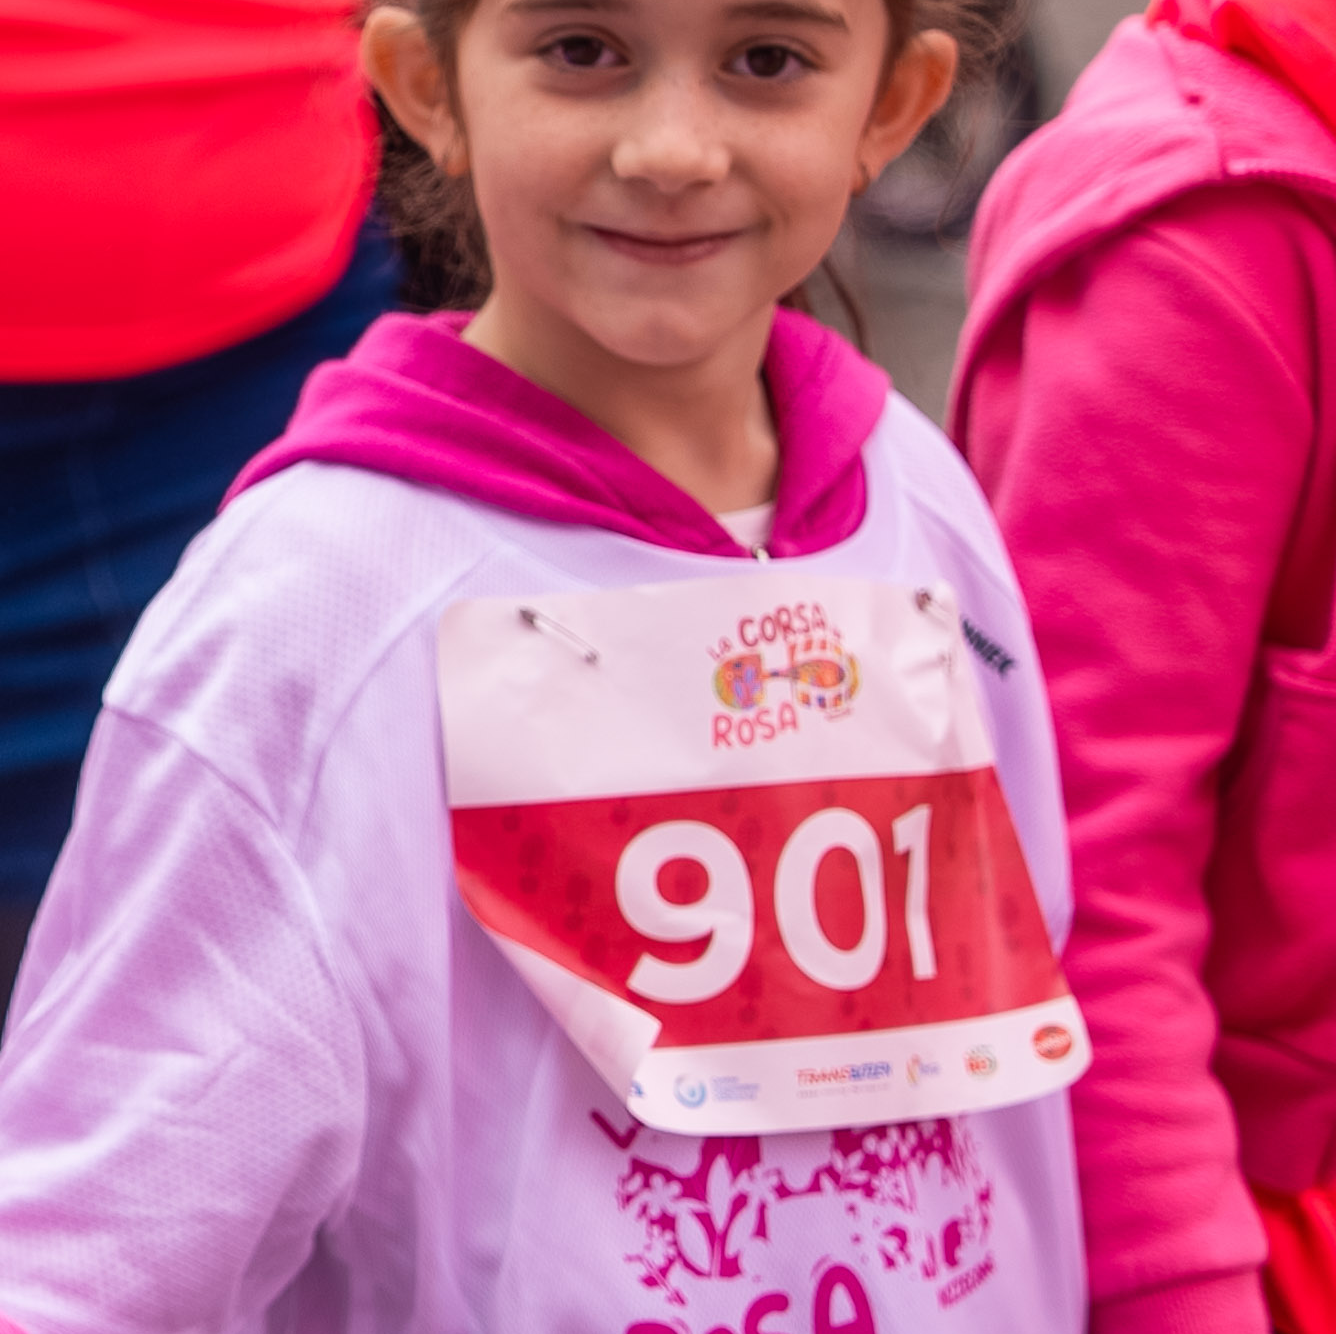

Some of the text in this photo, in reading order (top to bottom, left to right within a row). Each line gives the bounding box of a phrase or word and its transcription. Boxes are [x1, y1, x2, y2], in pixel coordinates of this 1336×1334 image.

[738, 602, 827, 649] CORSA
[712, 701, 798, 748] ROSA
[615, 803, 937, 1005] 901
[590, 1110, 638, 1149] L
